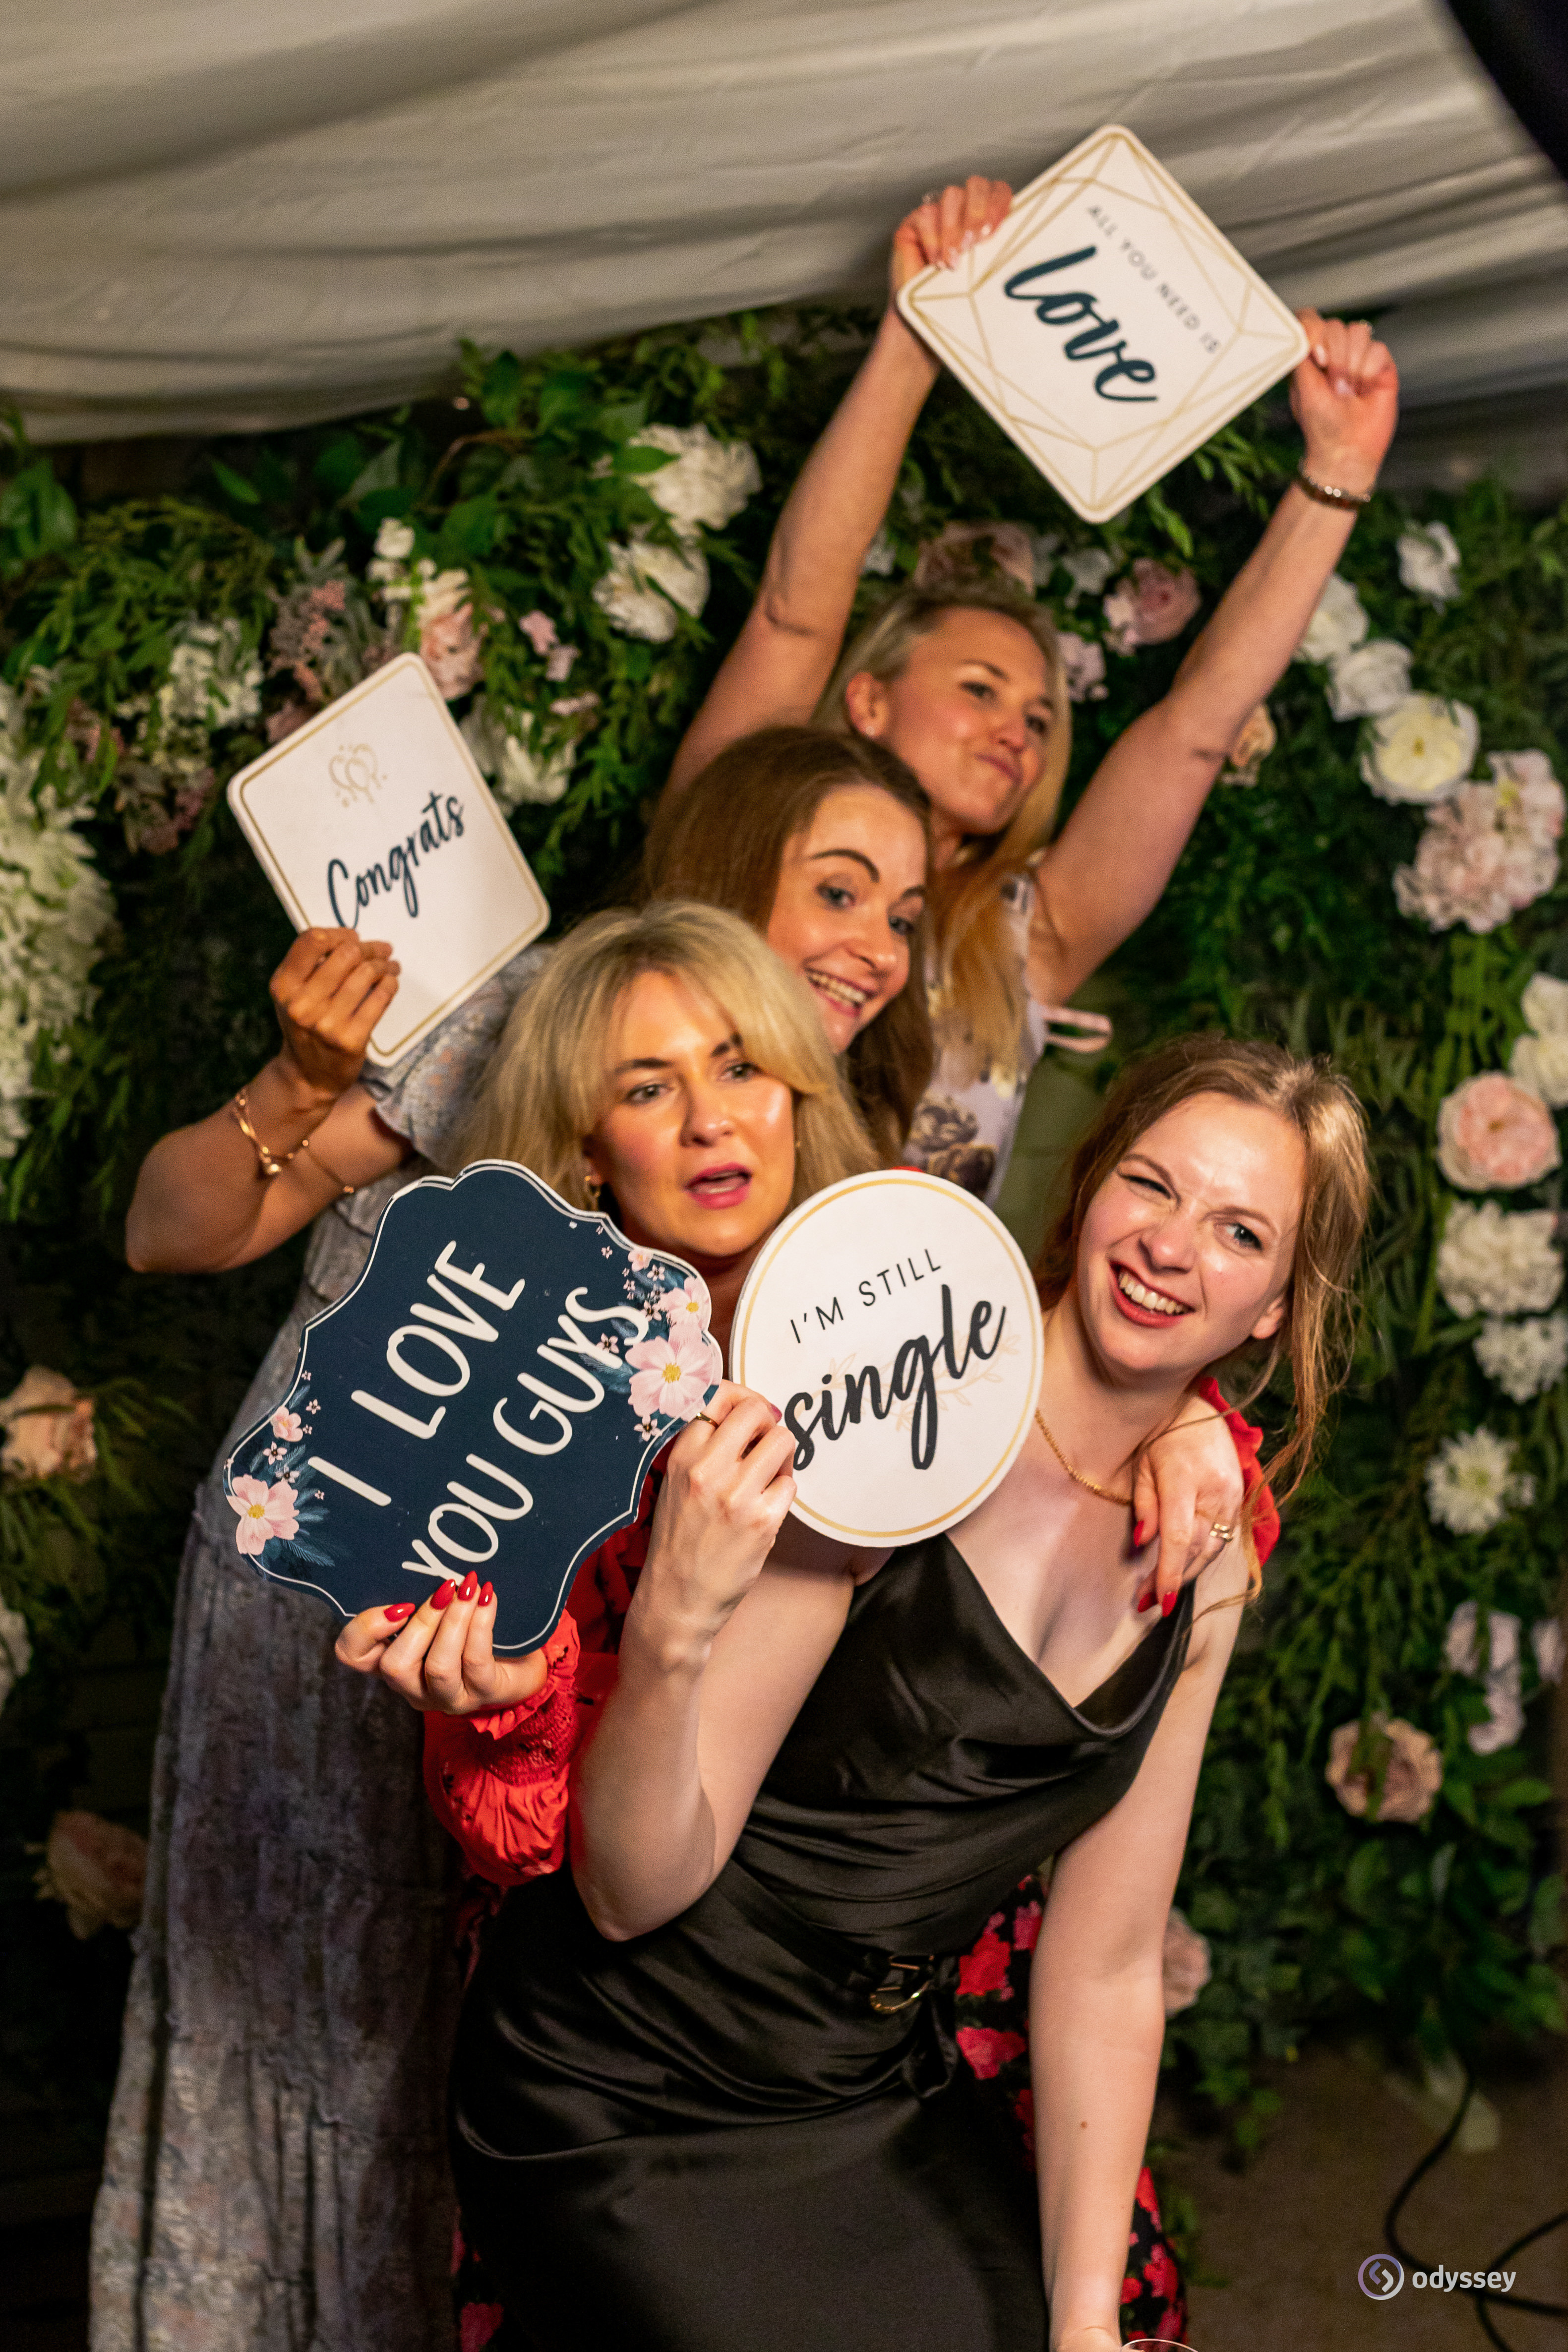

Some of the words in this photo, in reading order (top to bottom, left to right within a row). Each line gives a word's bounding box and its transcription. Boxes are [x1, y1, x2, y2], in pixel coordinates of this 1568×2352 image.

[1004, 245, 1159, 403] love
[1088, 205, 1118, 238] ALL
[1121, 239, 1156, 280] YOU
[1159, 281, 1201, 331] NEED
[1202, 334, 1220, 354] IS
[327, 790, 465, 929] Congrats
[858, 1248, 942, 1307] STILL
[307, 1456, 392, 1507] I
[351, 1240, 526, 1439] LOVE
[401, 1453, 534, 1586] YOU
[492, 1286, 649, 1456] GUYS
[784, 1284, 1007, 1471] single
